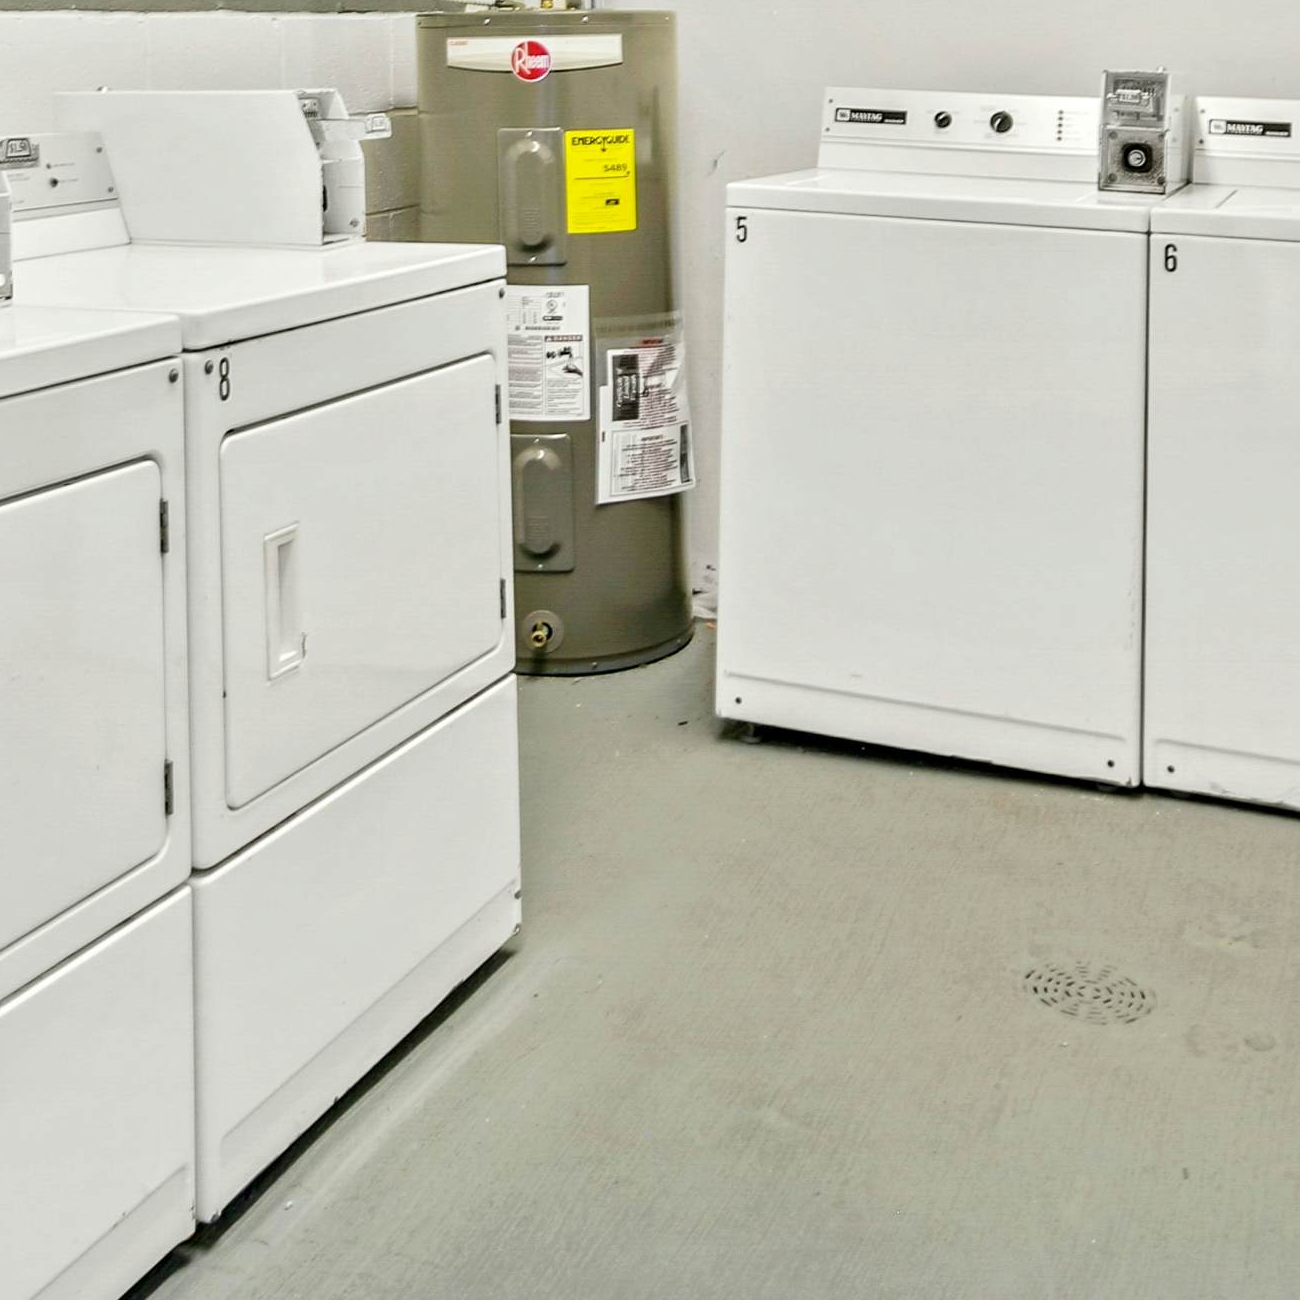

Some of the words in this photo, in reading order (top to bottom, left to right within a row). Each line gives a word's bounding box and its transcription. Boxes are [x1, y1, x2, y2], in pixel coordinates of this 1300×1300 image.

[514, 40, 550, 75] Rheem
[736, 216, 748, 243] 5
[1164, 243, 1178, 272] 6
[218, 357, 231, 402] 8
